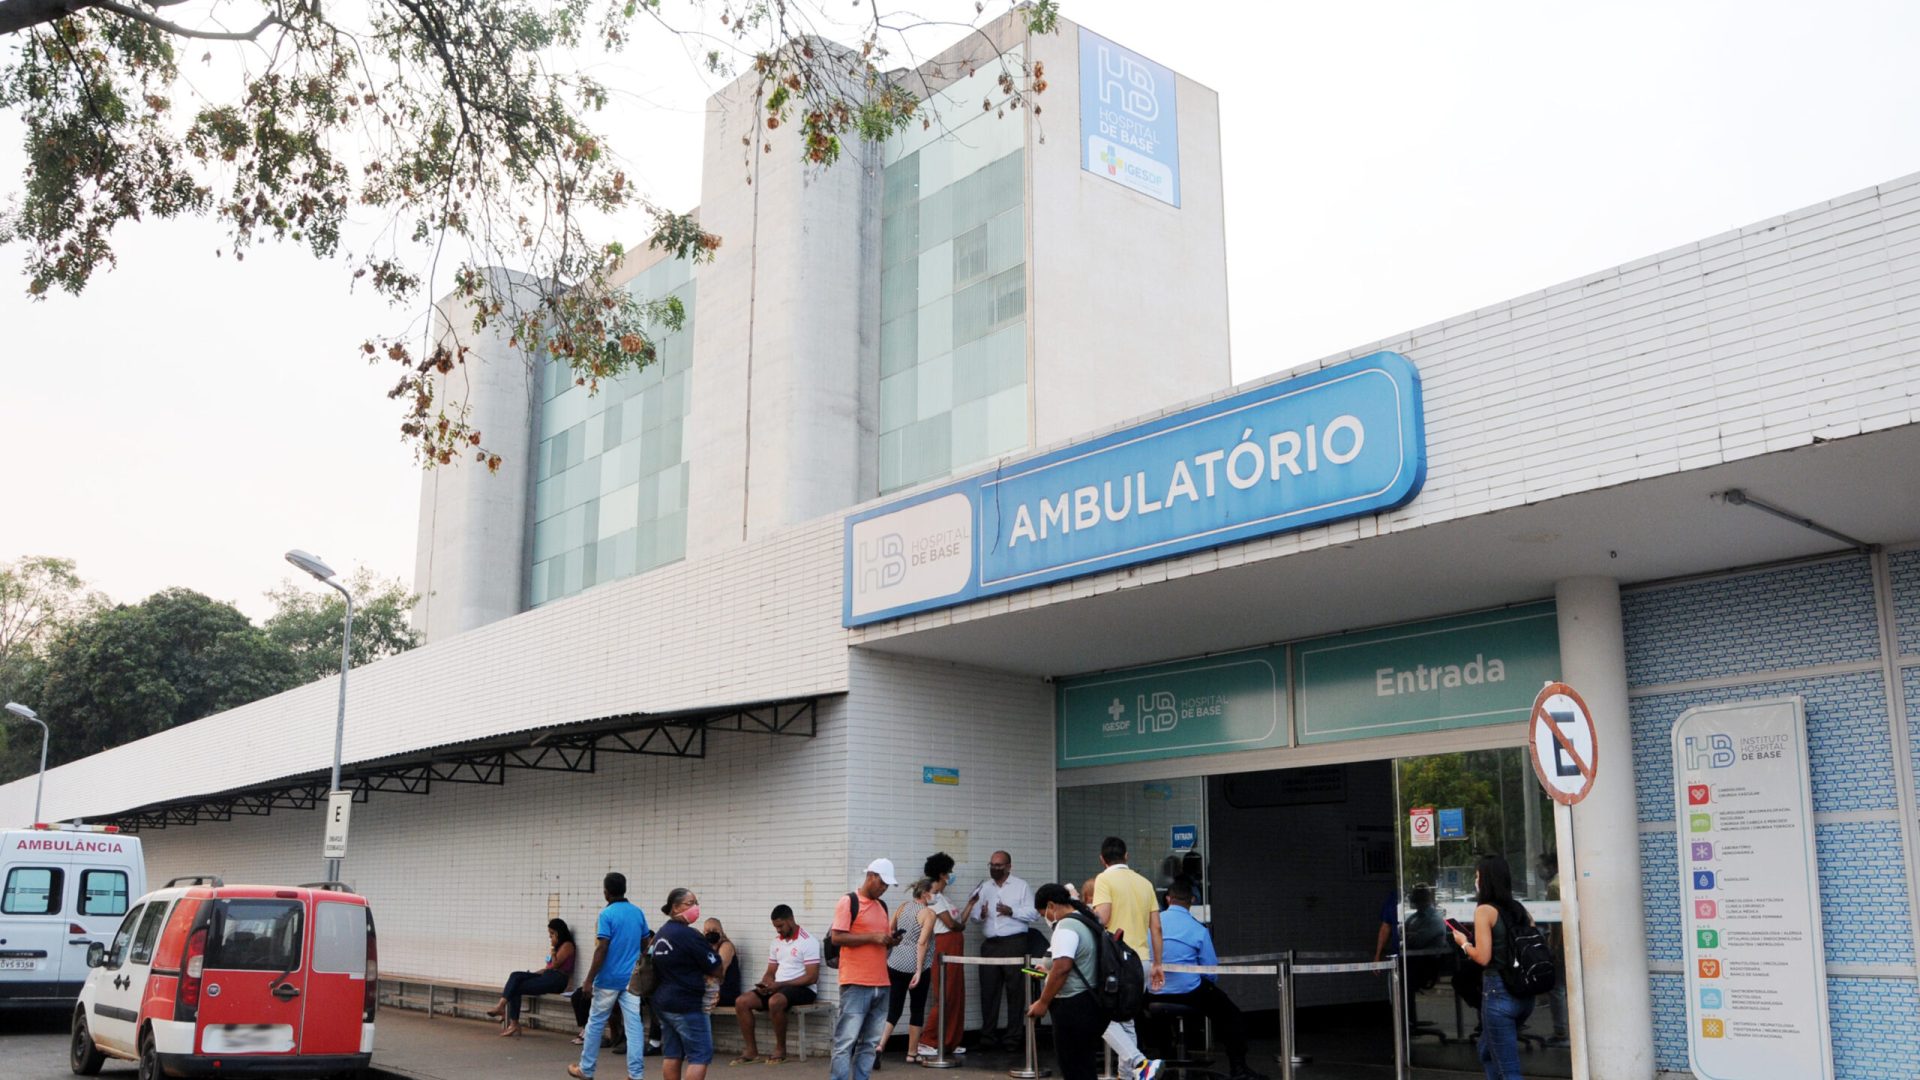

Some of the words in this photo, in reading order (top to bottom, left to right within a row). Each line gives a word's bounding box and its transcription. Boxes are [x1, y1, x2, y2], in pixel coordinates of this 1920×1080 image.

[1100, 106, 1160, 144] HOSPITAL
[1100, 119, 1117, 138] DE
[1121, 131, 1155, 154] BASE
[1009, 414, 1365, 548] AMBULATÓRIO
[911, 525, 969, 554] HOSPITAL
[911, 551, 927, 568] DE
[929, 542, 961, 562] BASE
[1376, 653, 1505, 697] Entrada
[1181, 694, 1229, 709] HOSPITAL
[1181, 708, 1194, 720] DE
[1196, 705, 1221, 718] BASE
[1740, 734, 1789, 746] INSTITUTO
[1741, 743, 1786, 753] HOSPITAL
[1741, 753, 1754, 761] DE
[1757, 751, 1782, 760] BASE
[335, 806, 342, 822] E
[16, 838, 123, 854] AMBULÂNCIA
